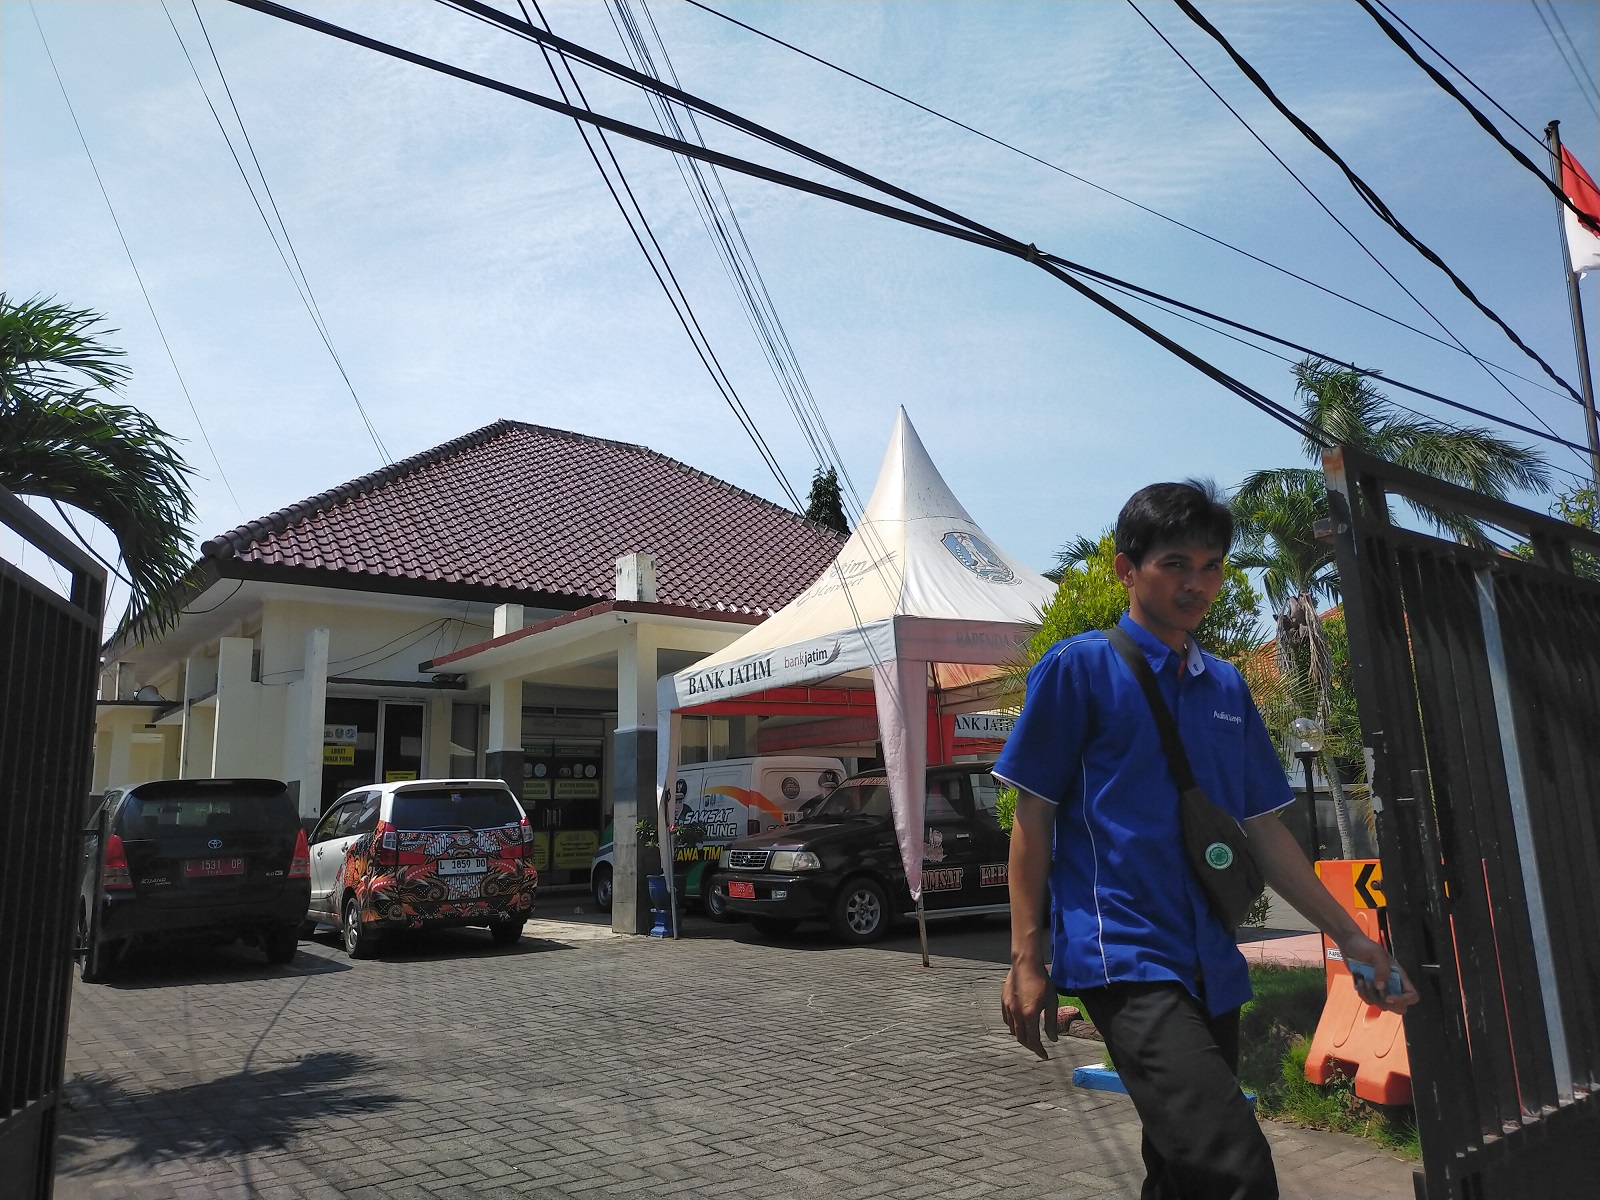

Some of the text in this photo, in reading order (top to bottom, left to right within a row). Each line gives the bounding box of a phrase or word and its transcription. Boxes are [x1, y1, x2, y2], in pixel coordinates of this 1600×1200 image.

[689, 648, 828, 695] BANK JATIM bankjatim
[955, 716, 981, 731] ANK
[684, 808, 734, 825] SAMSAT
[186, 863, 192, 872] L
[201, 860, 221, 870] 1531
[439, 862, 445, 870] L
[452, 860, 471, 870] 1859
[921, 866, 1009, 891] AMSAT KER
